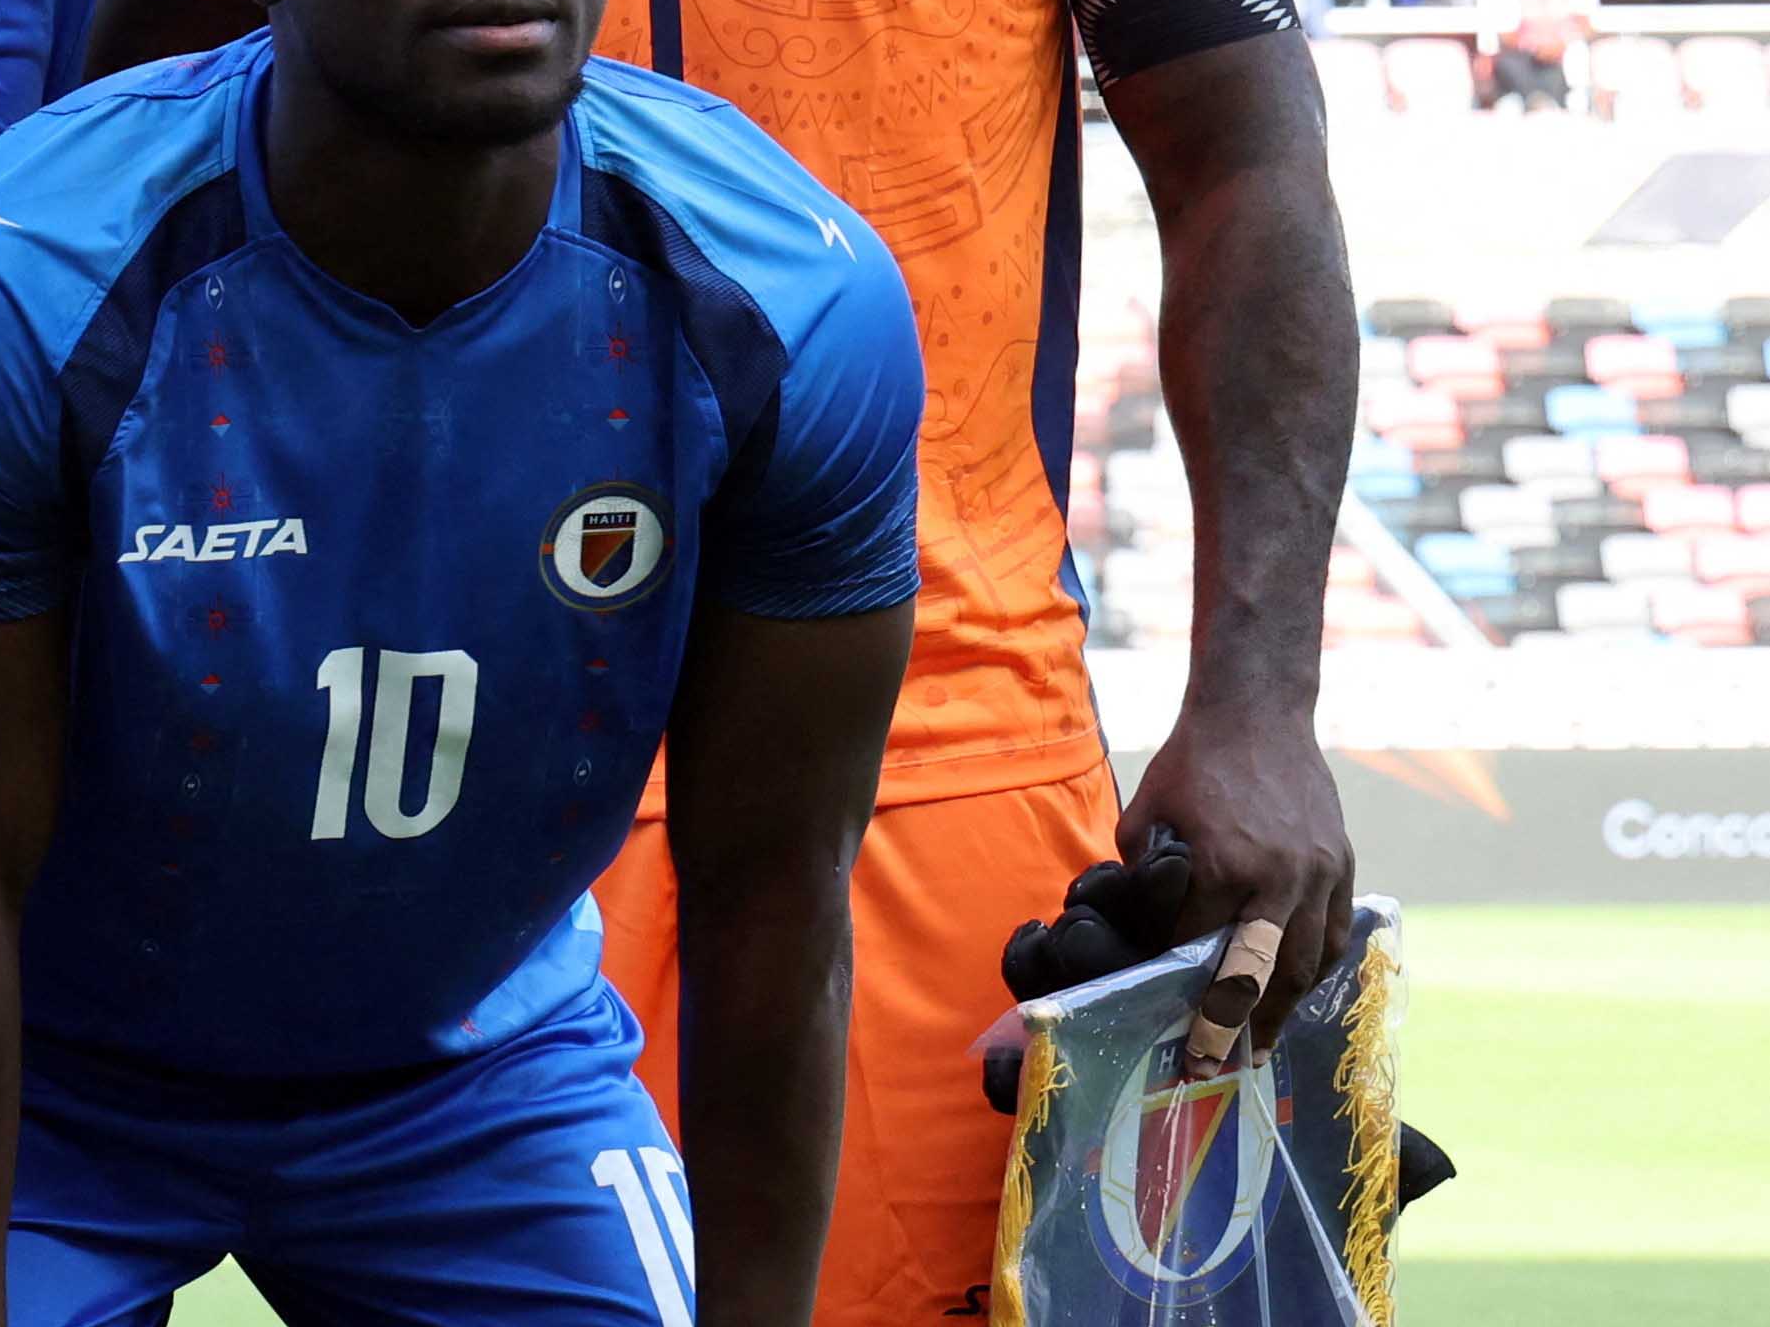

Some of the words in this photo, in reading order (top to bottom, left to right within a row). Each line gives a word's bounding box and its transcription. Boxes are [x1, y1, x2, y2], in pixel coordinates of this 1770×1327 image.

[117, 518, 309, 564] SAETA
[589, 513, 632, 526] HAITI
[310, 646, 479, 841] 10
